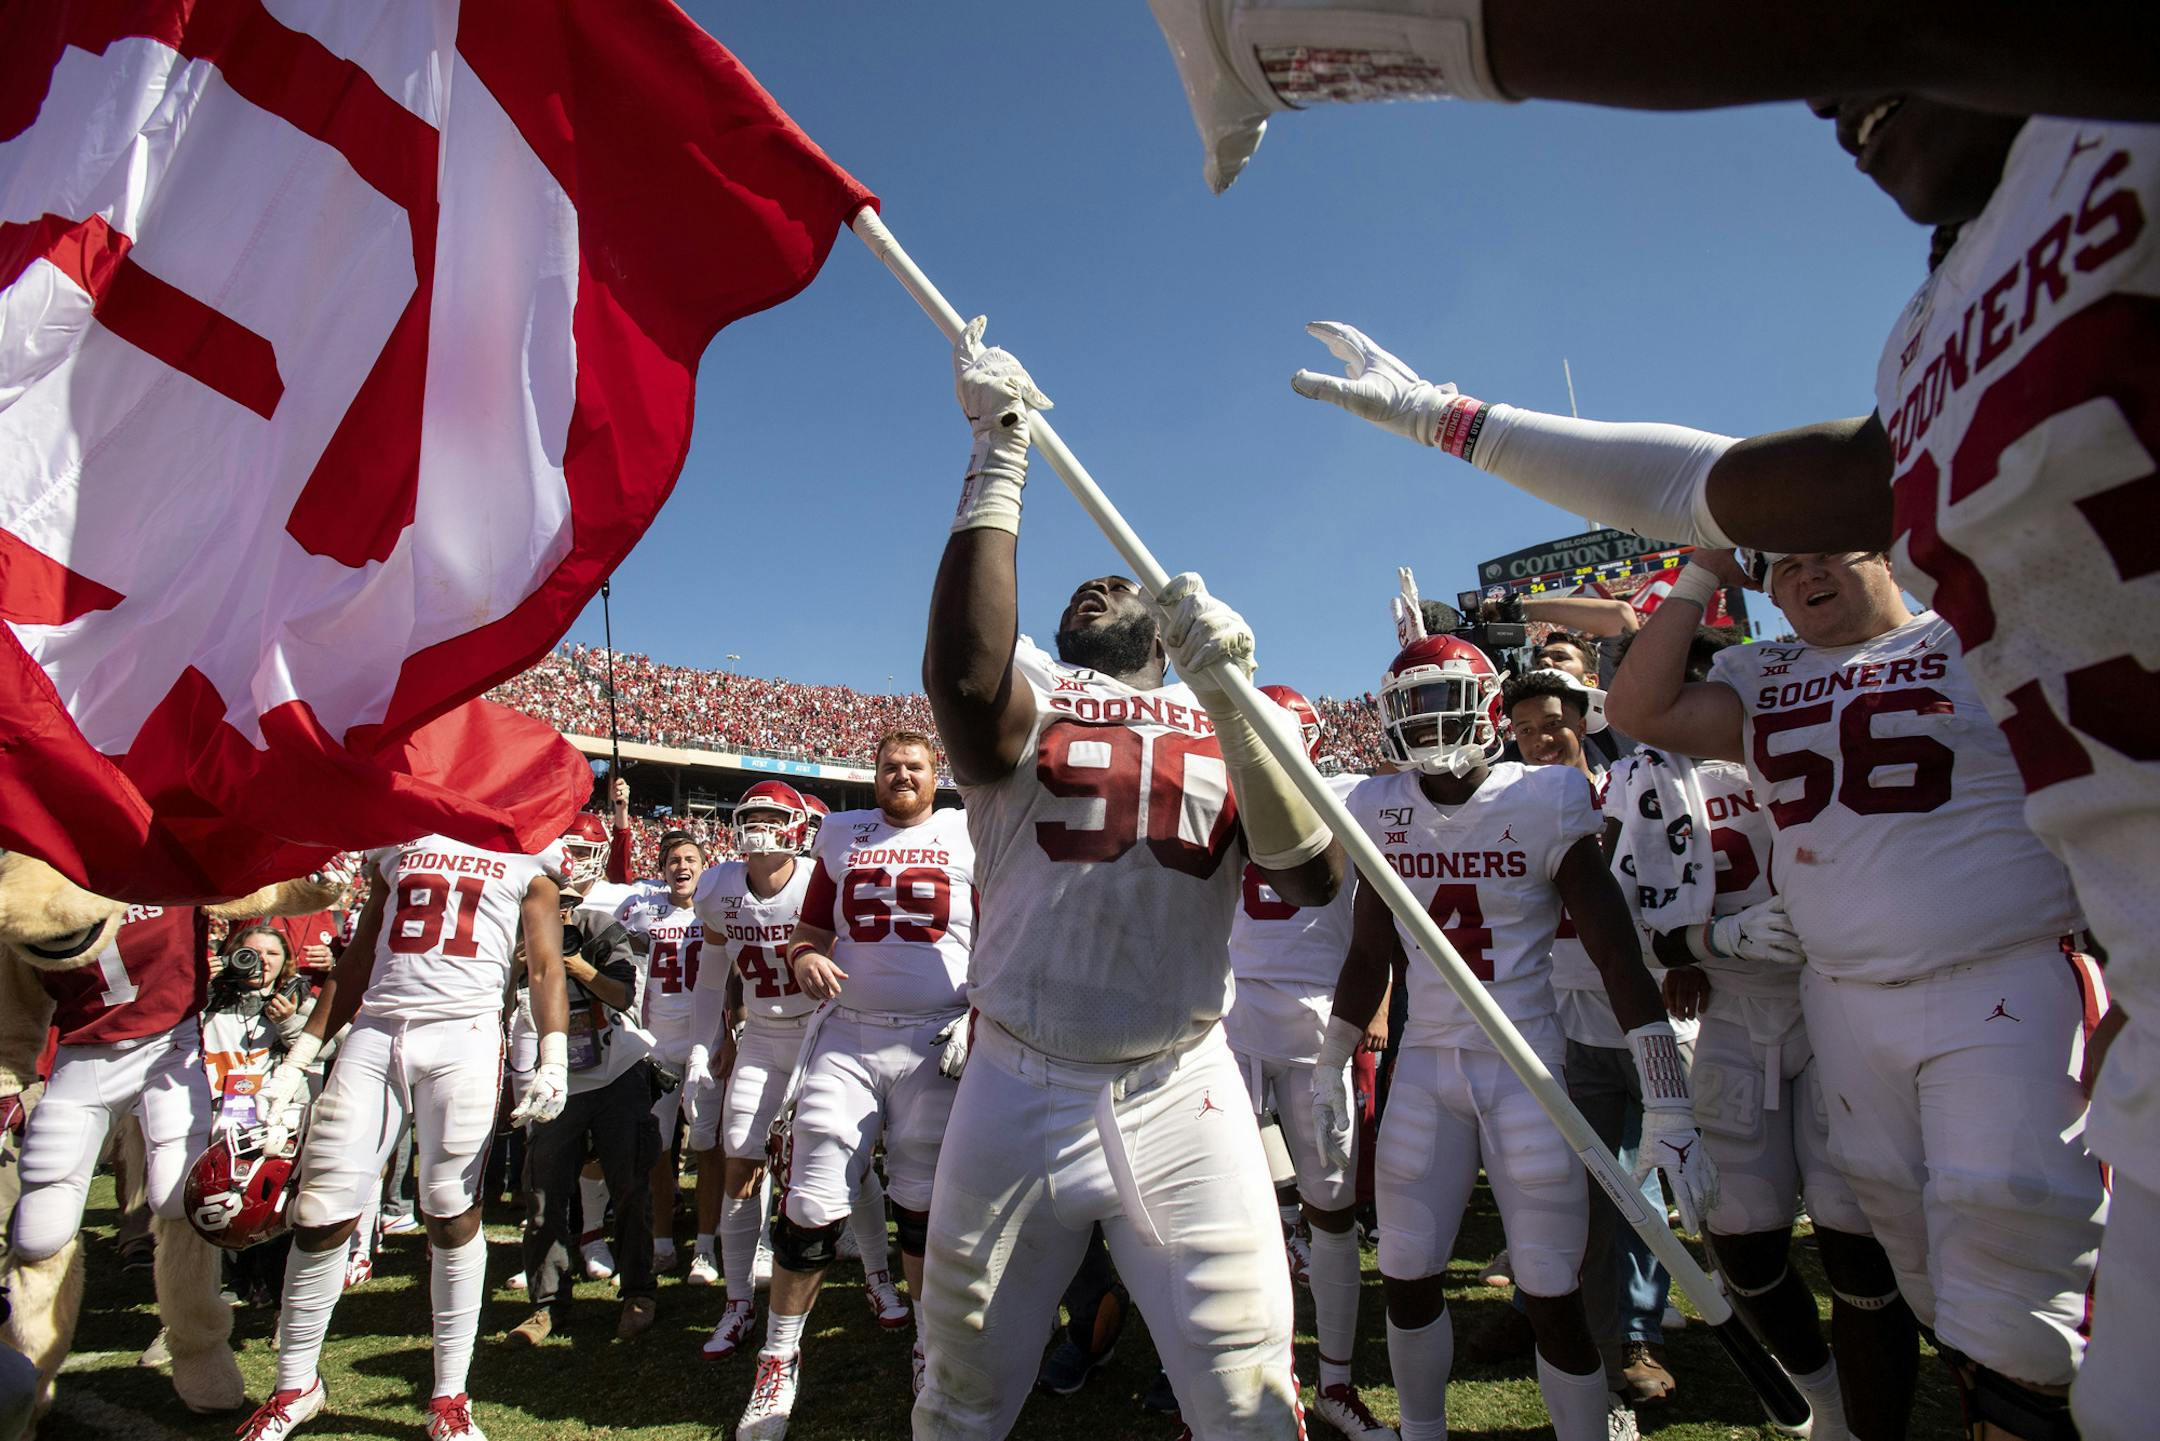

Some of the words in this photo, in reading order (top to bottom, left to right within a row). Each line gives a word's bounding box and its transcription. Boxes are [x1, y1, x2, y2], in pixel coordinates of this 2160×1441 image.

[1887, 149, 2145, 466] SOONERS
[1552, 534, 1604, 551] WELCOME
[1509, 540, 1611, 578] COTTON
[1614, 537, 1677, 559] BOW
[1663, 557, 1680, 569] 27
[1530, 582, 1546, 594] 34
[1760, 664, 1793, 678] XII
[1054, 675, 1090, 694] XII
[1756, 653, 1949, 710] SOONERS
[1050, 696, 1216, 735] SOONER
[751, 760, 769, 768] AT&T
[795, 764, 811, 773] AT&T
[1752, 687, 1955, 832] 56
[1034, 717, 1239, 880] 90
[855, 834, 870, 843] XII
[1384, 830, 1408, 845] XII
[397, 852, 507, 880] SOONERS
[848, 848, 950, 867] SOONERS
[1384, 850, 1527, 879] SOONERS
[842, 867, 950, 943] 69
[388, 872, 485, 959] 81
[724, 910, 738, 920] XII
[649, 926, 705, 941] SOONE
[726, 924, 795, 942] SOONER
[1417, 883, 1495, 981] 4
